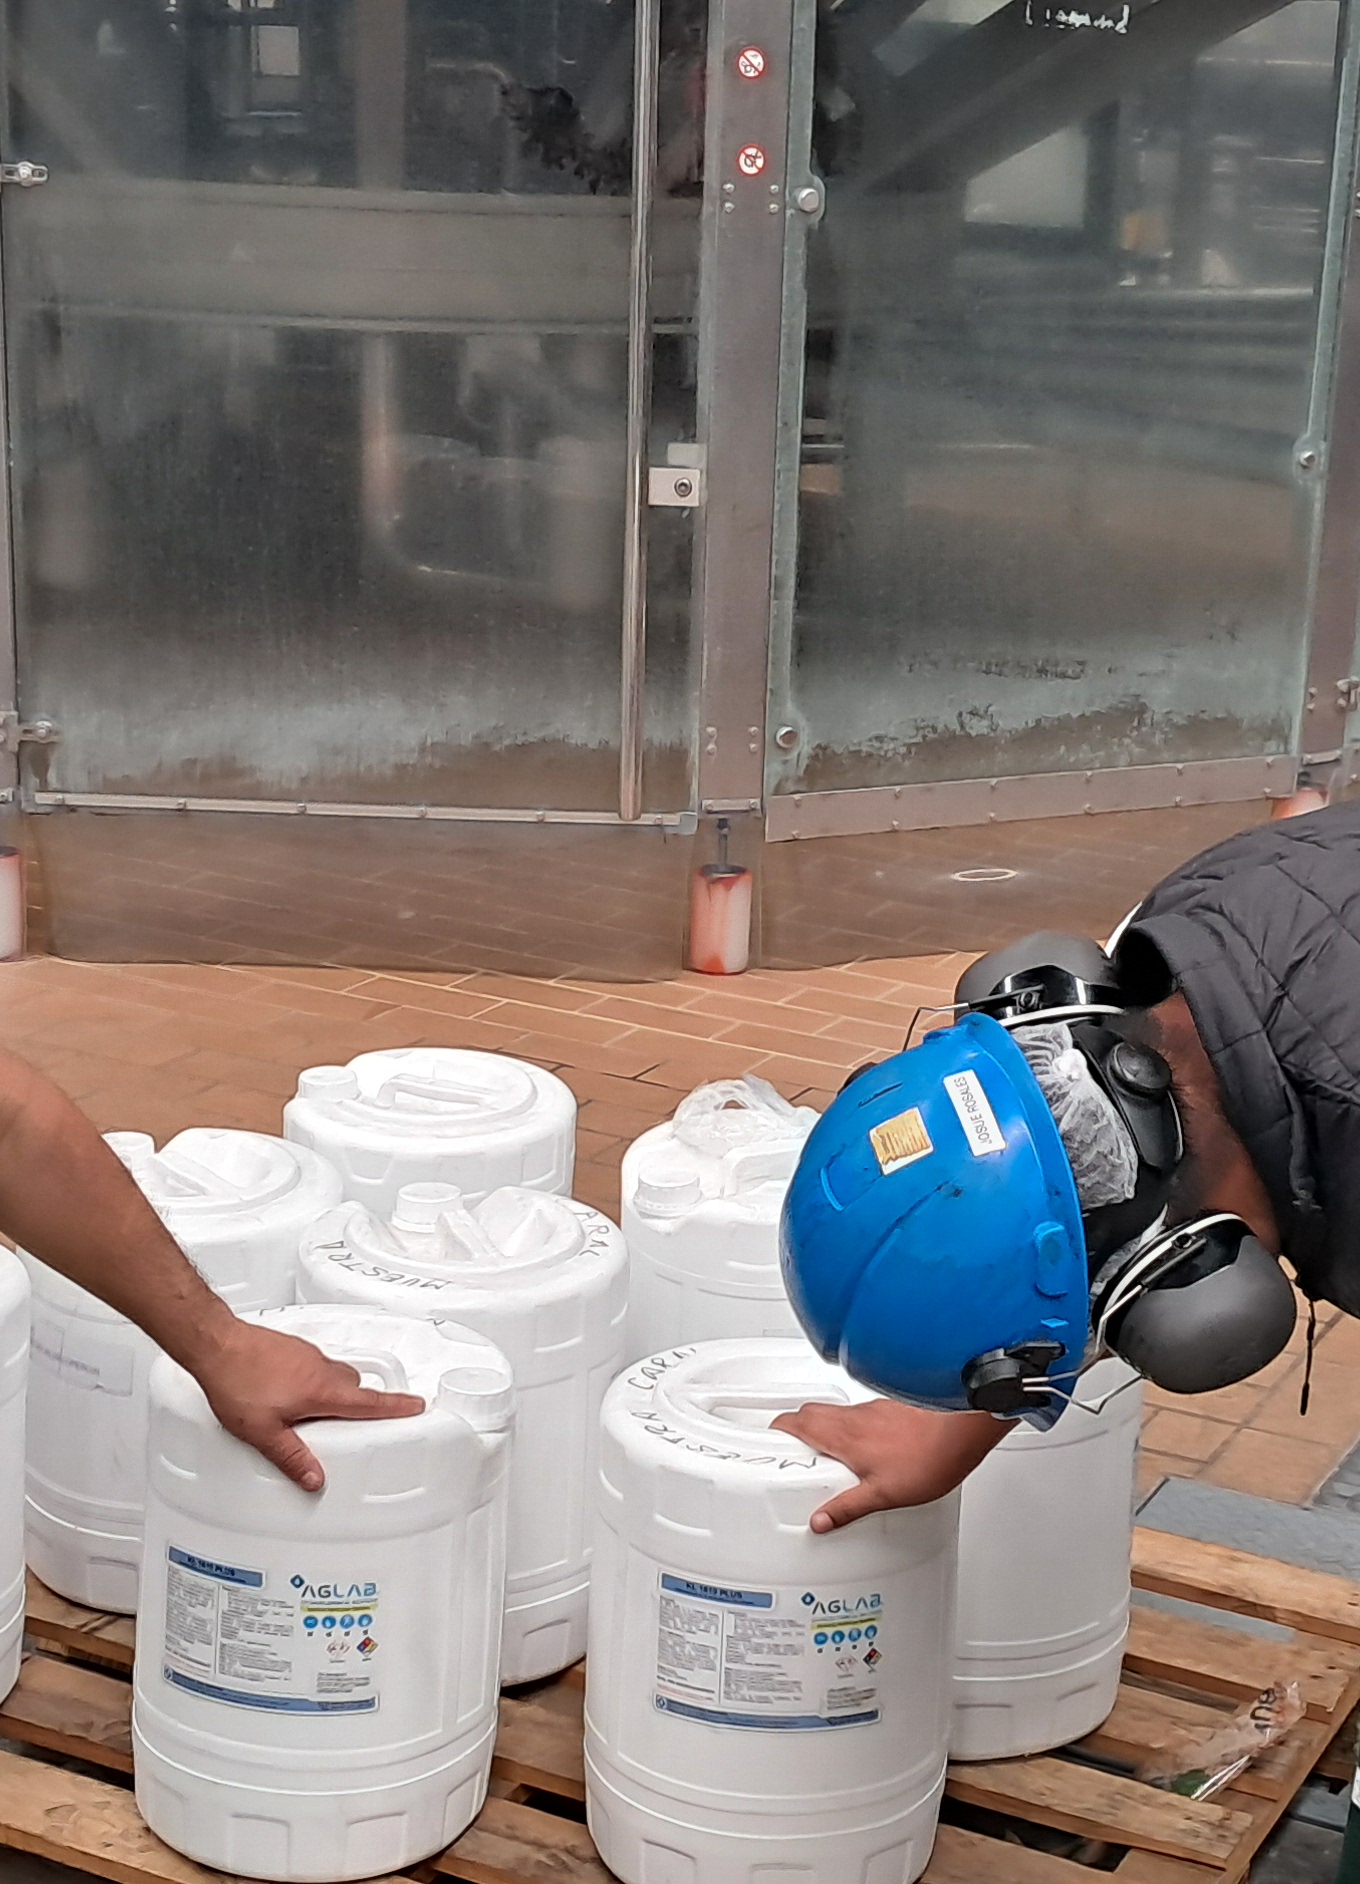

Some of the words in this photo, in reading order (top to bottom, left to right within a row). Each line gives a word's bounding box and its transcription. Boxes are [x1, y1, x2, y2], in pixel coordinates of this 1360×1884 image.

[953, 1076, 979, 1113] ROSALES
[312, 1240, 455, 1290] MUESTRA
[629, 1410, 818, 1470] MUESTRA
[301, 1582, 377, 1599] AGLAB
[812, 1593, 881, 1616] AGLAB
